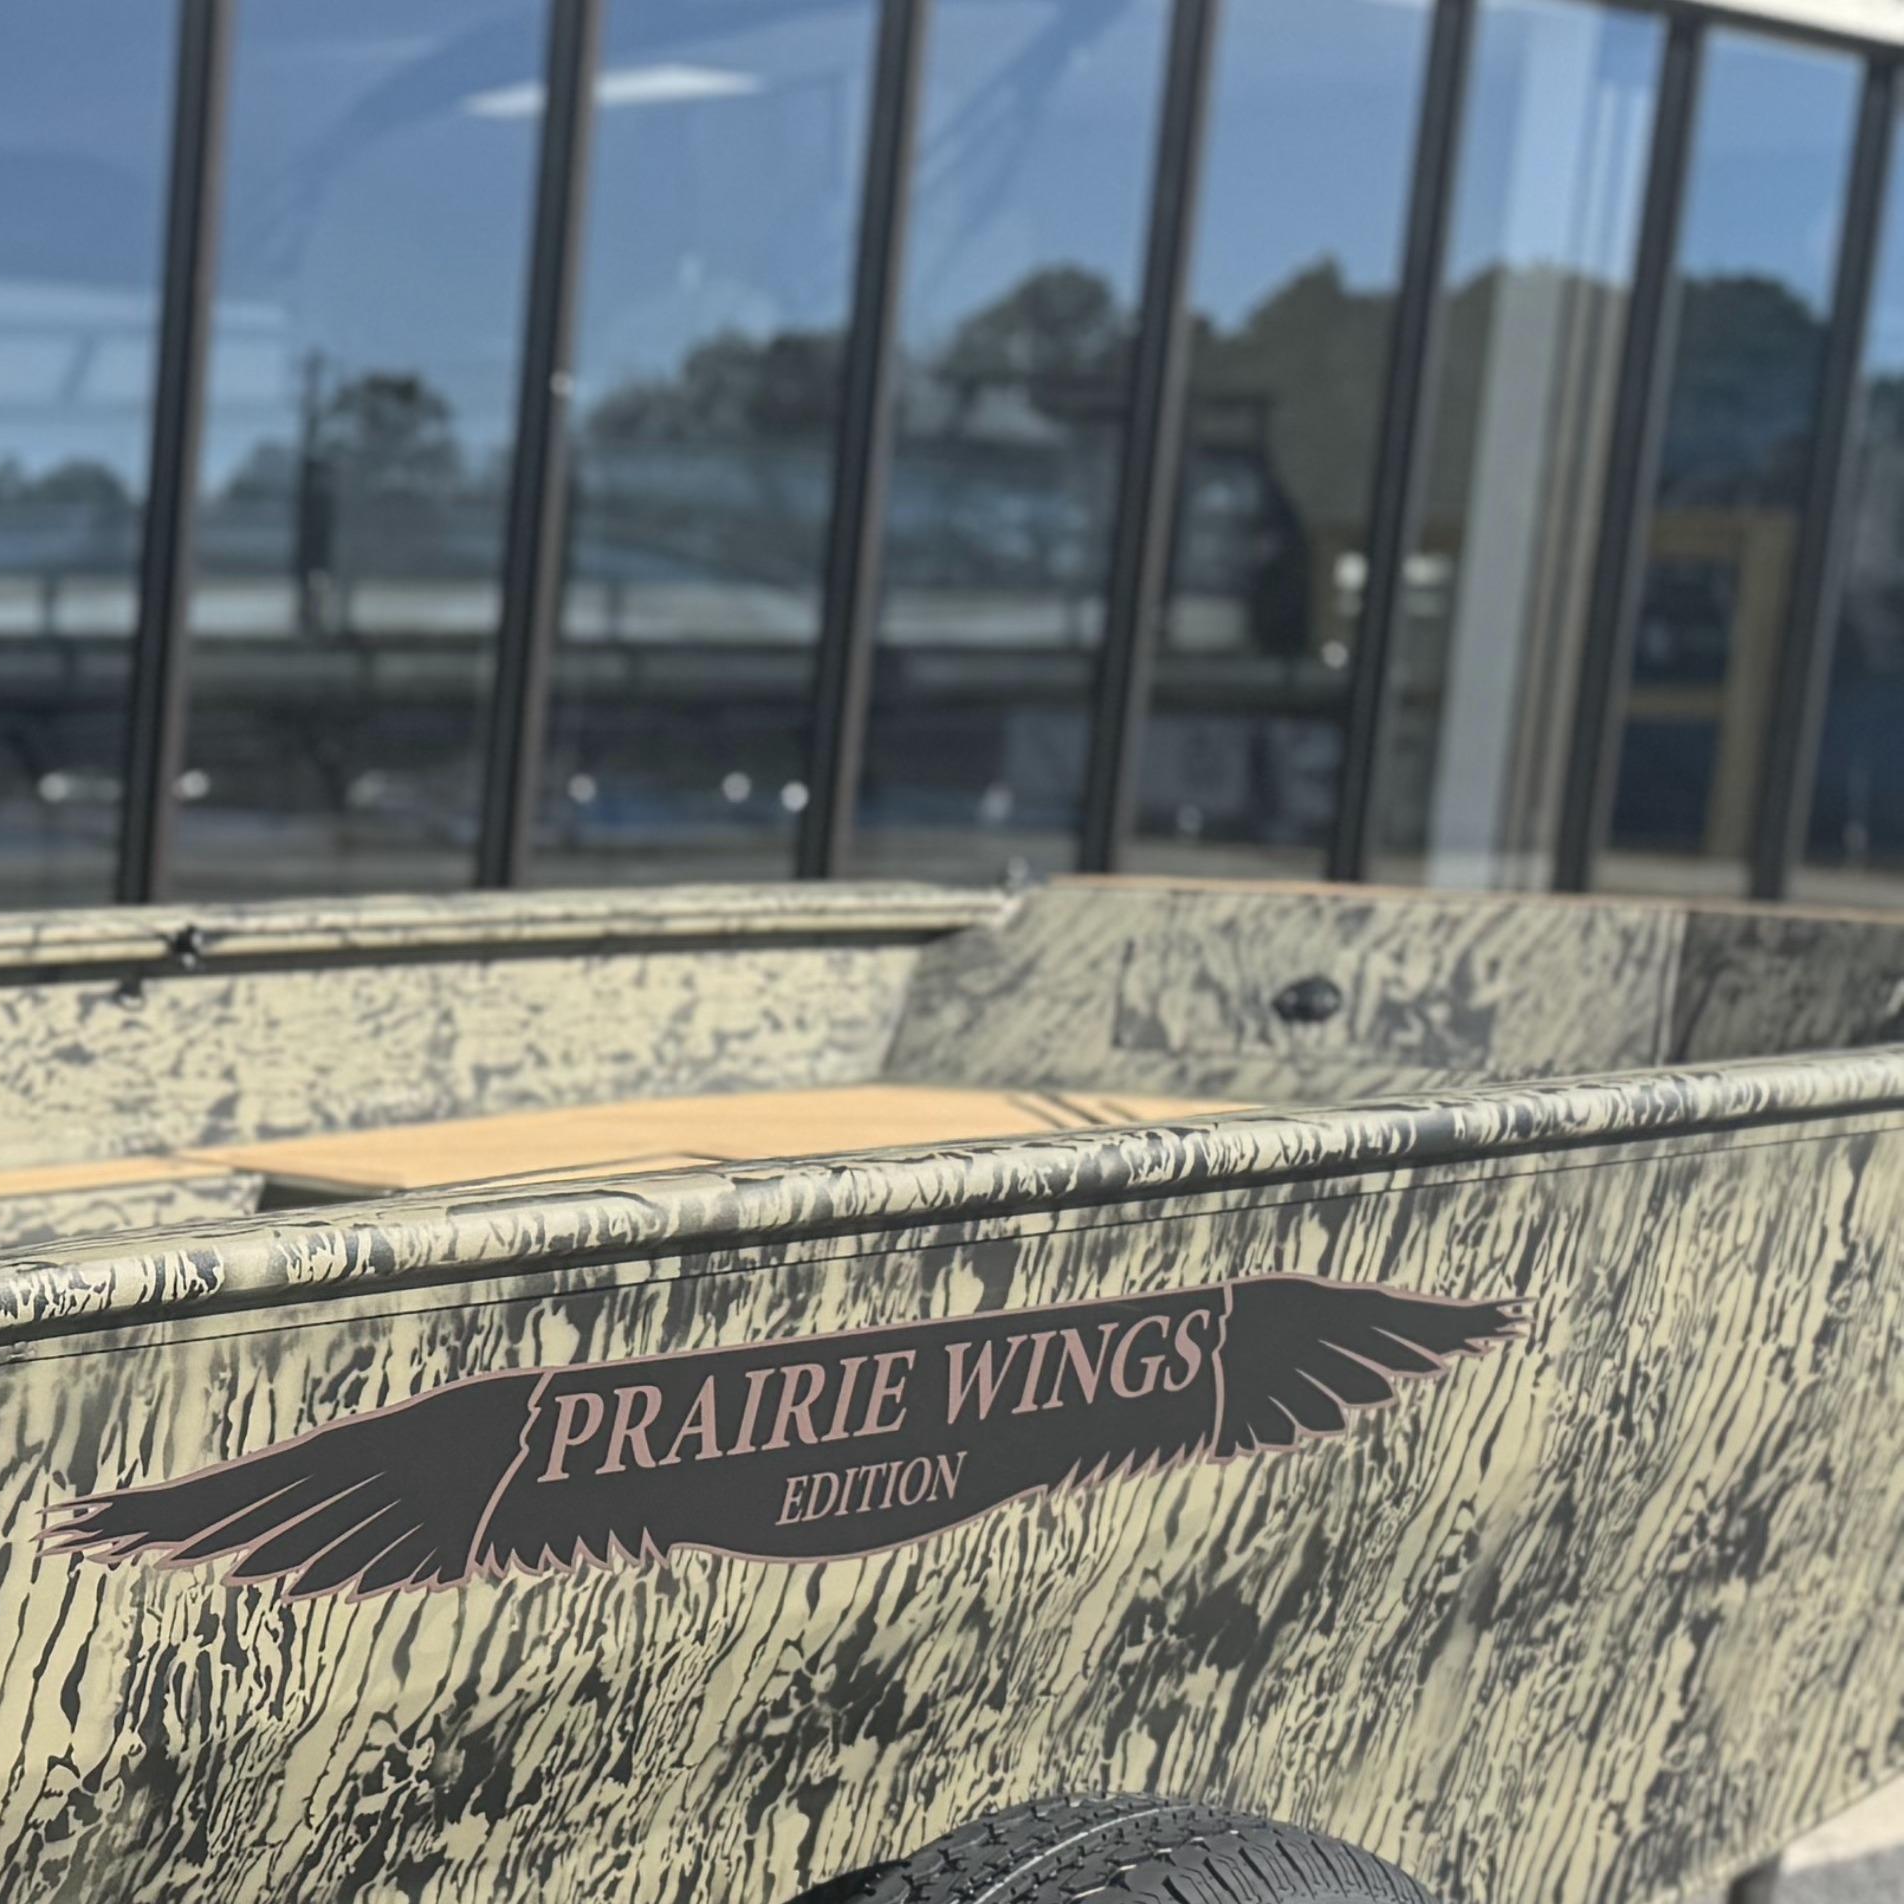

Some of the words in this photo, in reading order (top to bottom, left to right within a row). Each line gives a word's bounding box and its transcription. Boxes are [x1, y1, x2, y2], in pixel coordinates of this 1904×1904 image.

[537, 1348, 918, 1483] PRAIRIE
[944, 1308, 1212, 1425] WINGS
[774, 1450, 969, 1527] EDITION
